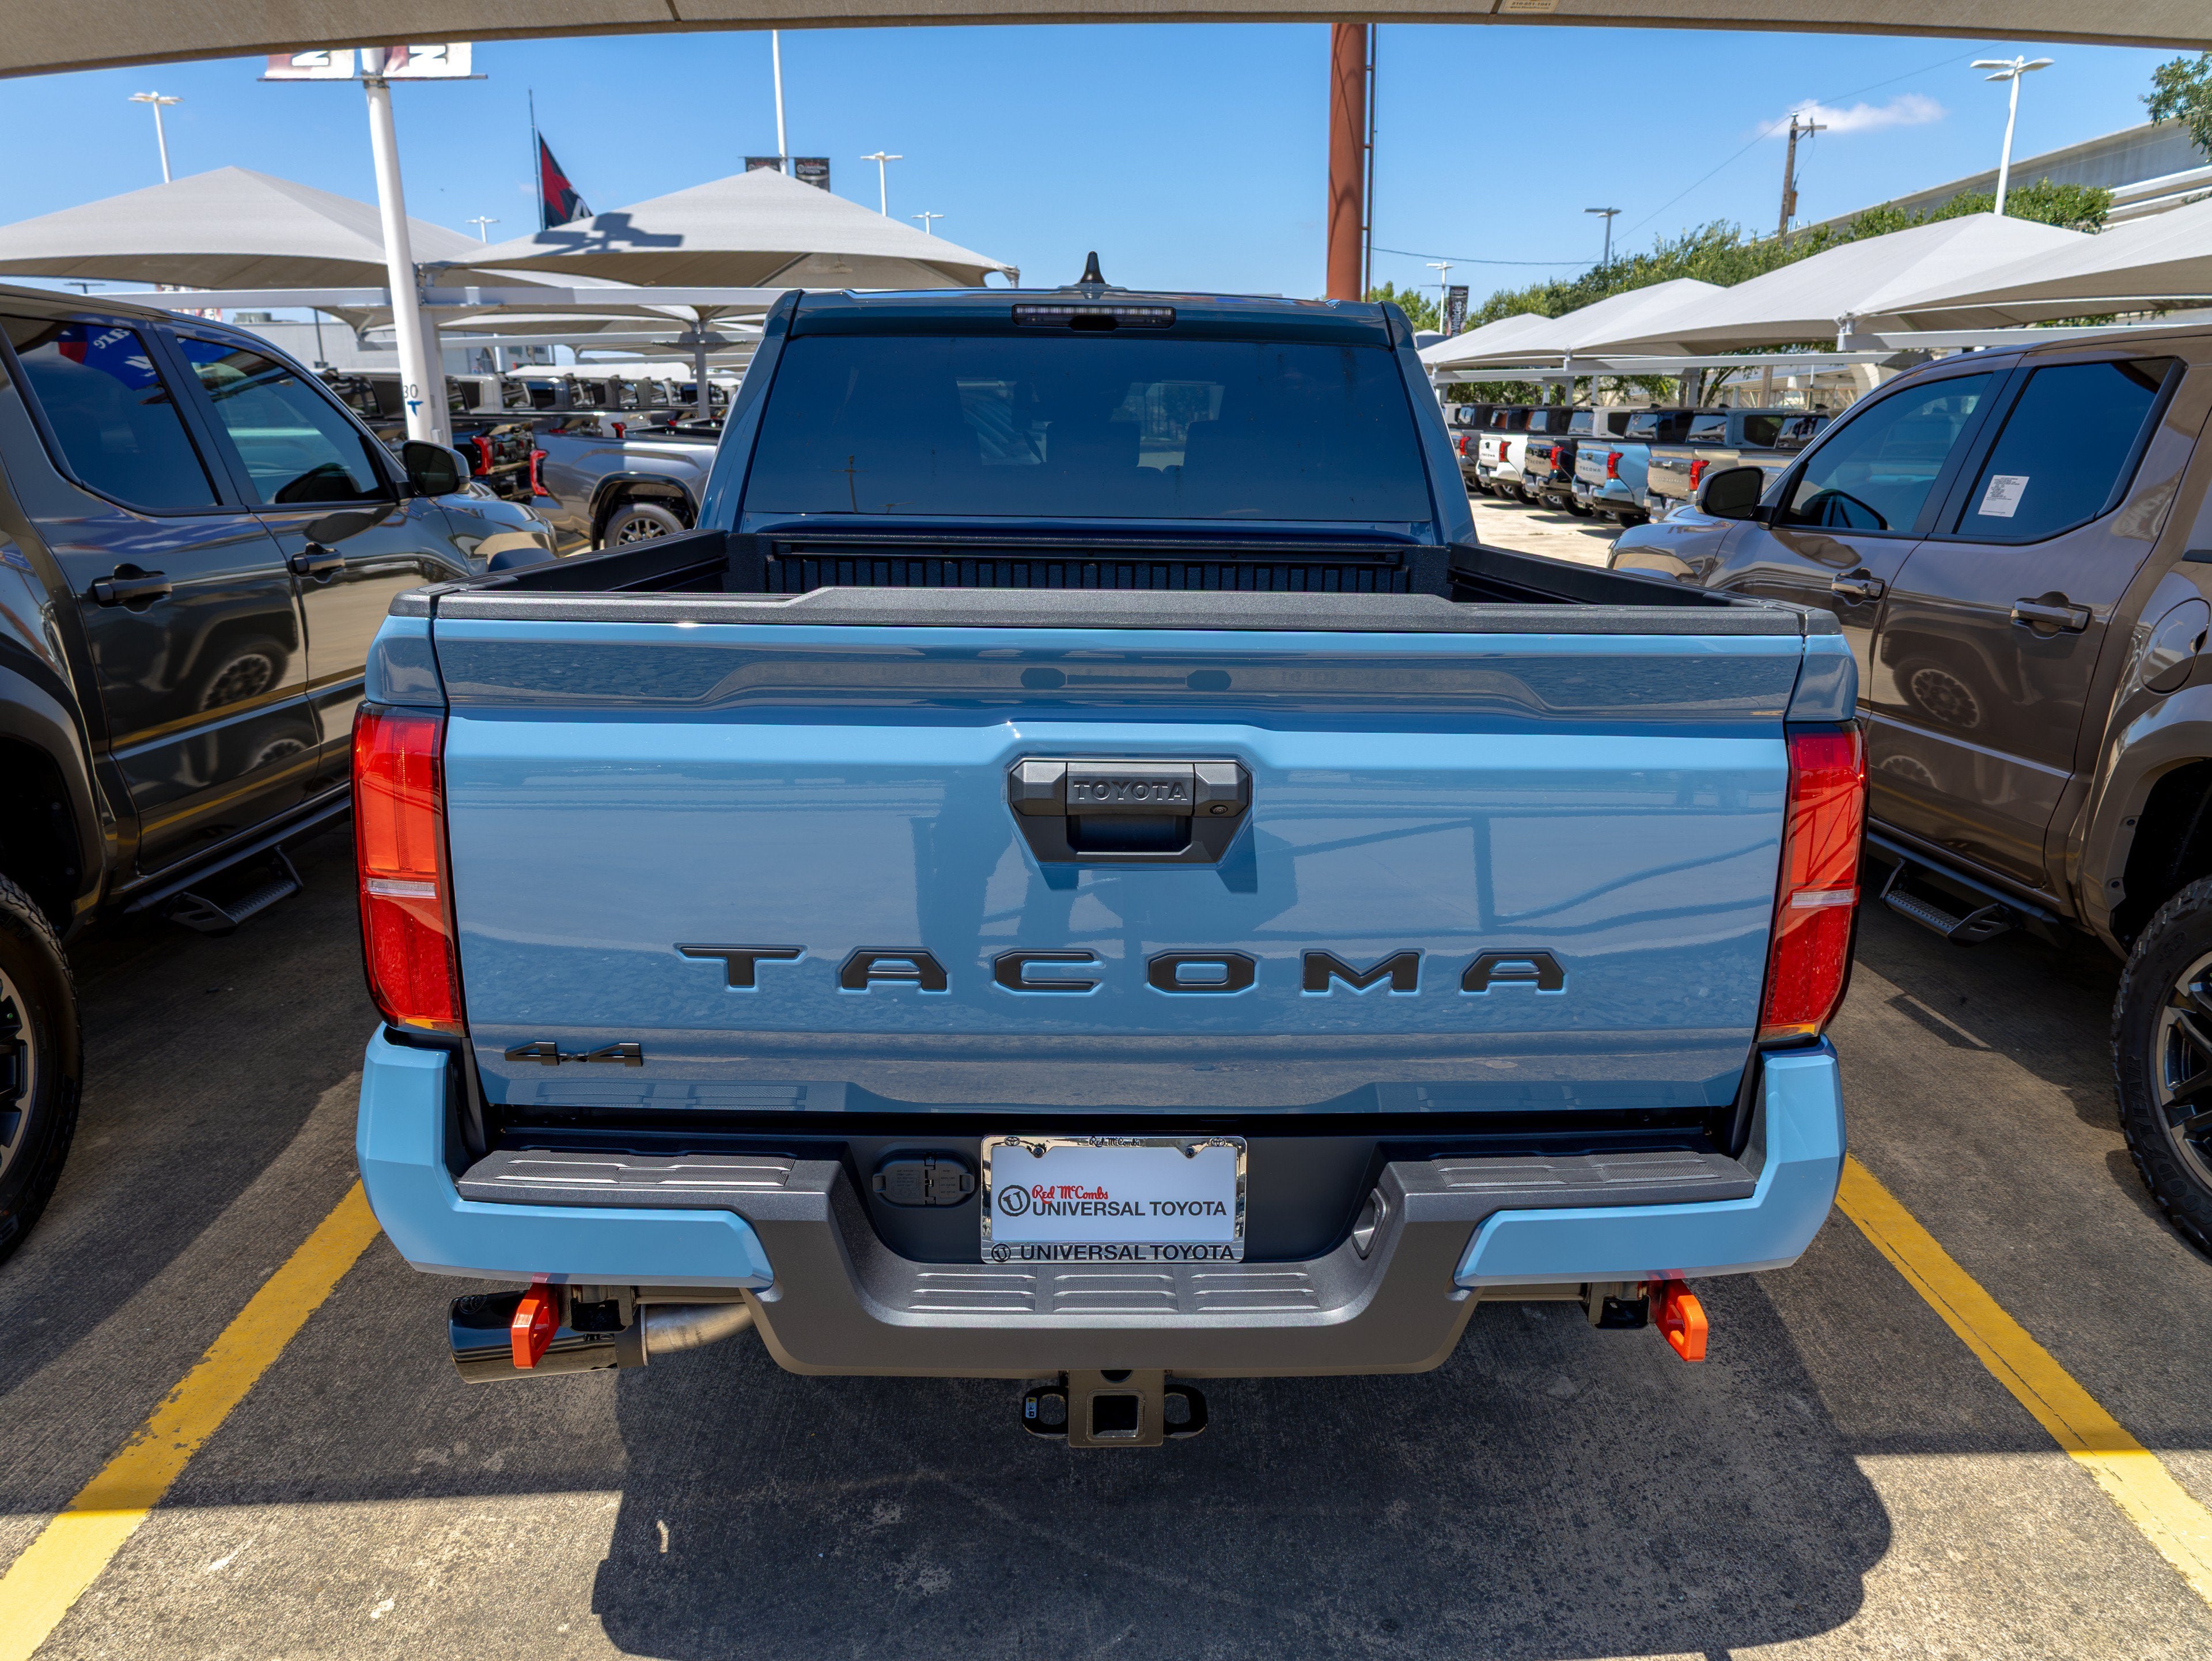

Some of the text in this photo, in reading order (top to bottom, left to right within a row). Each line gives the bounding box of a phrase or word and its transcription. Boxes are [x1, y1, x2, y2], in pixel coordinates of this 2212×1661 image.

[1074, 780, 1188, 801] TOYOTA
[677, 944, 1567, 996] TACOMA
[1089, 1136, 1104, 1146] Red
[1032, 1185, 1109, 1201] Red McCombs
[1033, 1201, 1227, 1217] UNIVERSAL TOYOTA
[1021, 1244, 1234, 1261] UNIVERSAL TOYOTA
